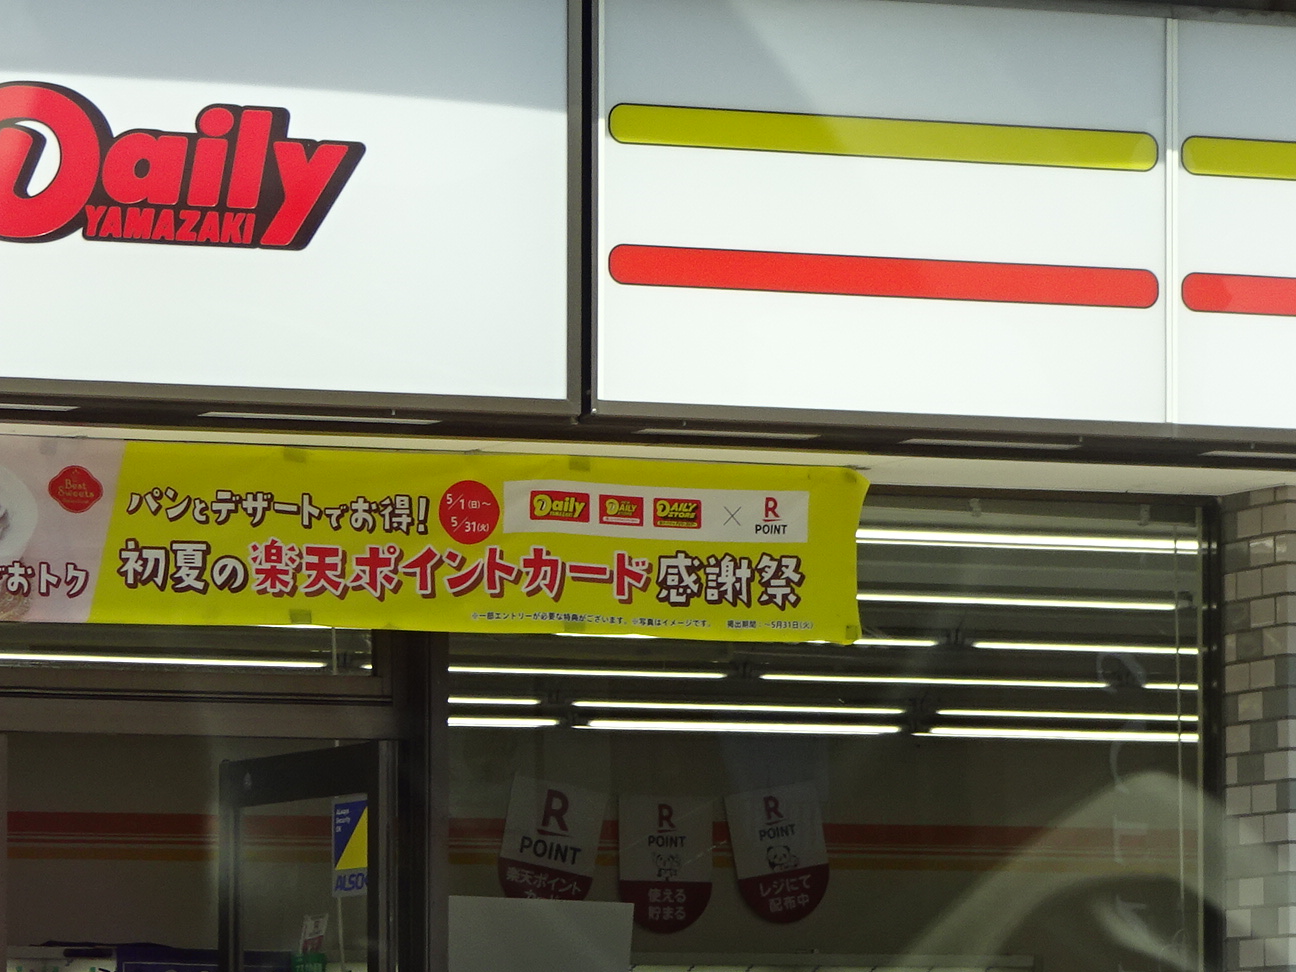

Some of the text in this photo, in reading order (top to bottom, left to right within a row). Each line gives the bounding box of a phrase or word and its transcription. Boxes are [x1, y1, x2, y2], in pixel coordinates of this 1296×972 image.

[84, 204, 256, 245] YAMAZAKI
[126, 486, 431, 536] パンとデザートでお得!
[533, 494, 586, 518] Daily
[764, 497, 781, 518] R
[755, 524, 788, 536] POINT
[118, 536, 806, 612] 初夏の楽天ポイントカード感謝祭
[648, 835, 686, 848] POINT
[759, 824, 796, 841] POINT
[520, 836, 581, 865] POINT
[335, 873, 368, 892] ALSO
[506, 866, 581, 895] 楽天ポイント
[648, 888, 687, 903] 使える
